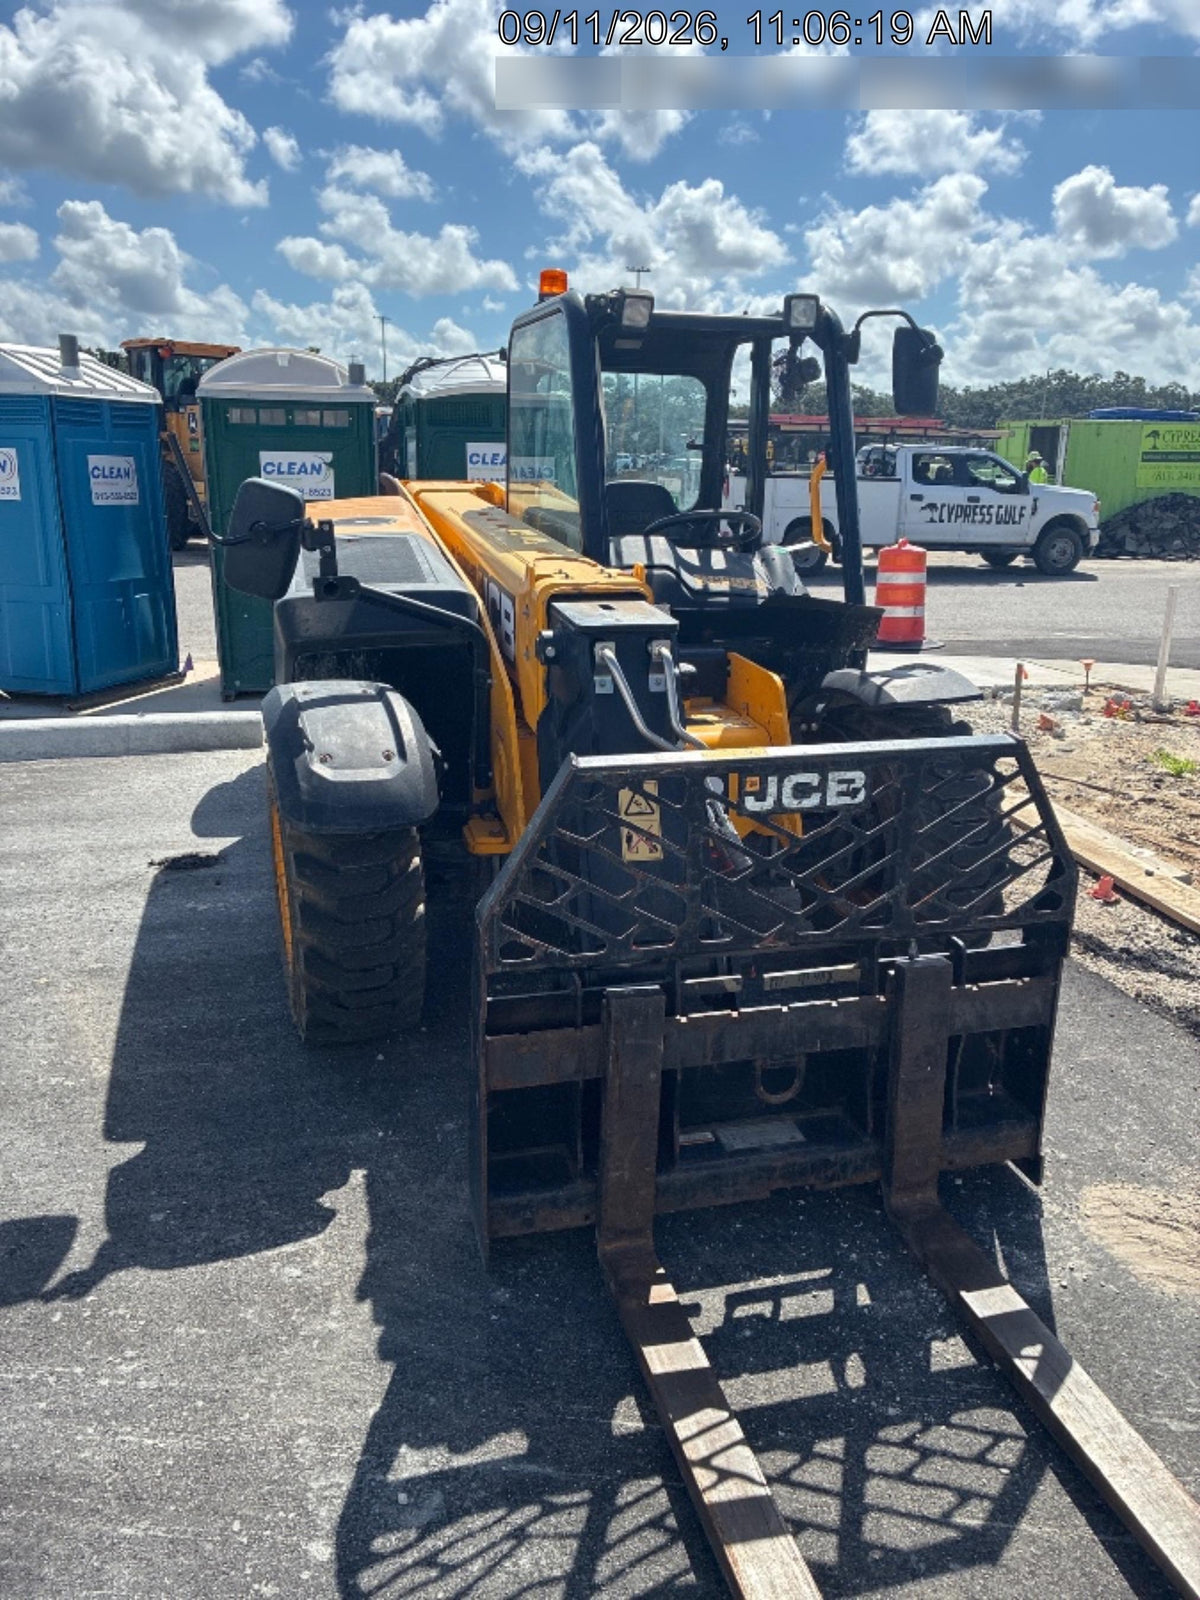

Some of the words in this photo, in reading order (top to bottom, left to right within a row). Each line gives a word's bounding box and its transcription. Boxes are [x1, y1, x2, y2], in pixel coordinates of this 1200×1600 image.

[1162, 430, 1200, 443] CYPRE
[469, 452, 506, 466] CLEA
[91, 465, 131, 480] CLEAN
[262, 461, 323, 476] CLEAN
[938, 502, 995, 524] CYPRESS
[995, 503, 1028, 525] GULF
[744, 770, 867, 812] JCB
